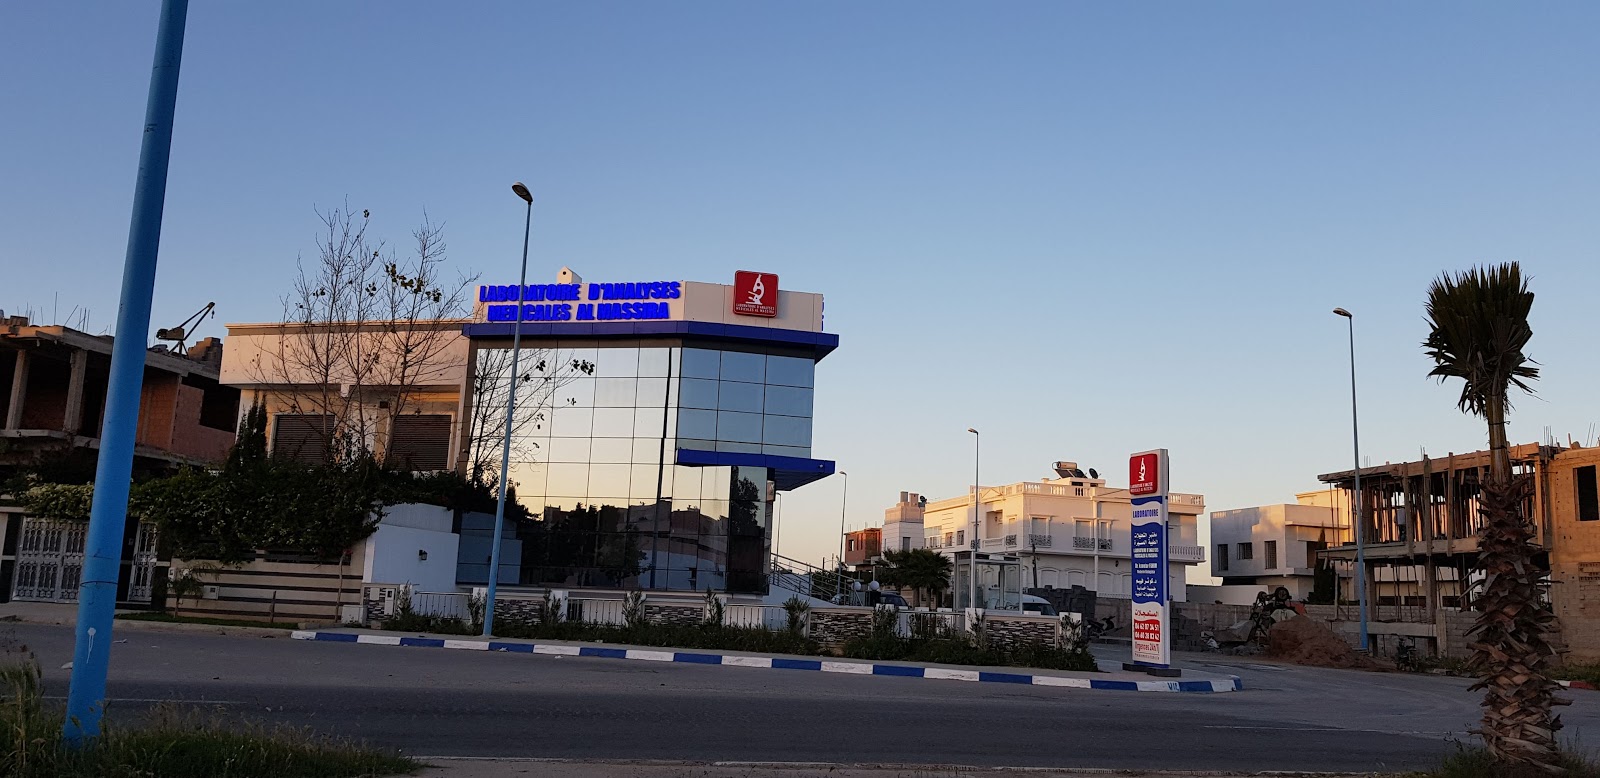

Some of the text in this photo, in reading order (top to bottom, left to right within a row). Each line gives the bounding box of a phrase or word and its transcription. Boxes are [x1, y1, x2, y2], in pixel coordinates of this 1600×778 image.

[479, 281, 681, 302] LABORATOIRE D'ANALYSES
[487, 302, 670, 321] MEDICALES AL MASSIRA
[1133, 509, 1159, 518] LABORATOIRE
